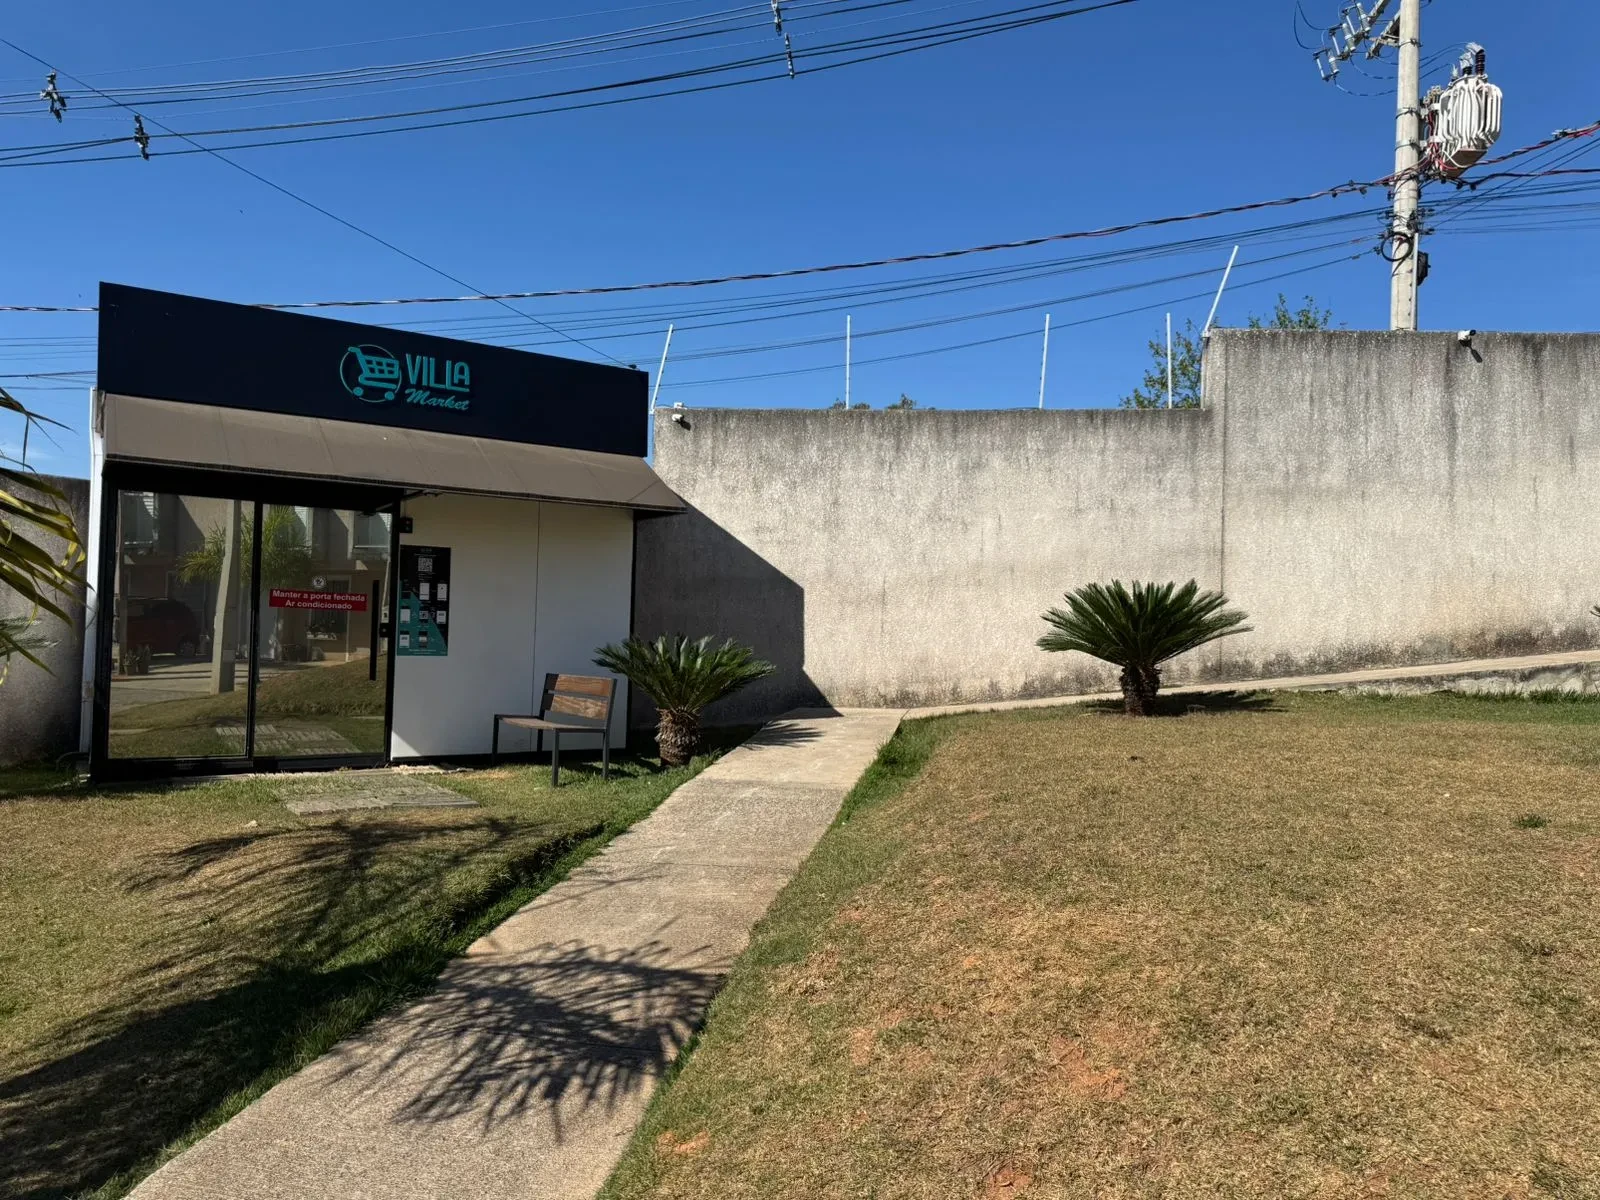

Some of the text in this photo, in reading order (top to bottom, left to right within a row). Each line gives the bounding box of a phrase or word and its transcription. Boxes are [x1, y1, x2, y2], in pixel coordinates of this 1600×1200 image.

[405, 353, 471, 392] VILLA
[404, 388, 470, 411] Market
[272, 589, 301, 599] Manter
[310, 592, 332, 601] porta
[333, 593, 365, 602] fechada
[285, 599, 353, 610] Ar condicionado
